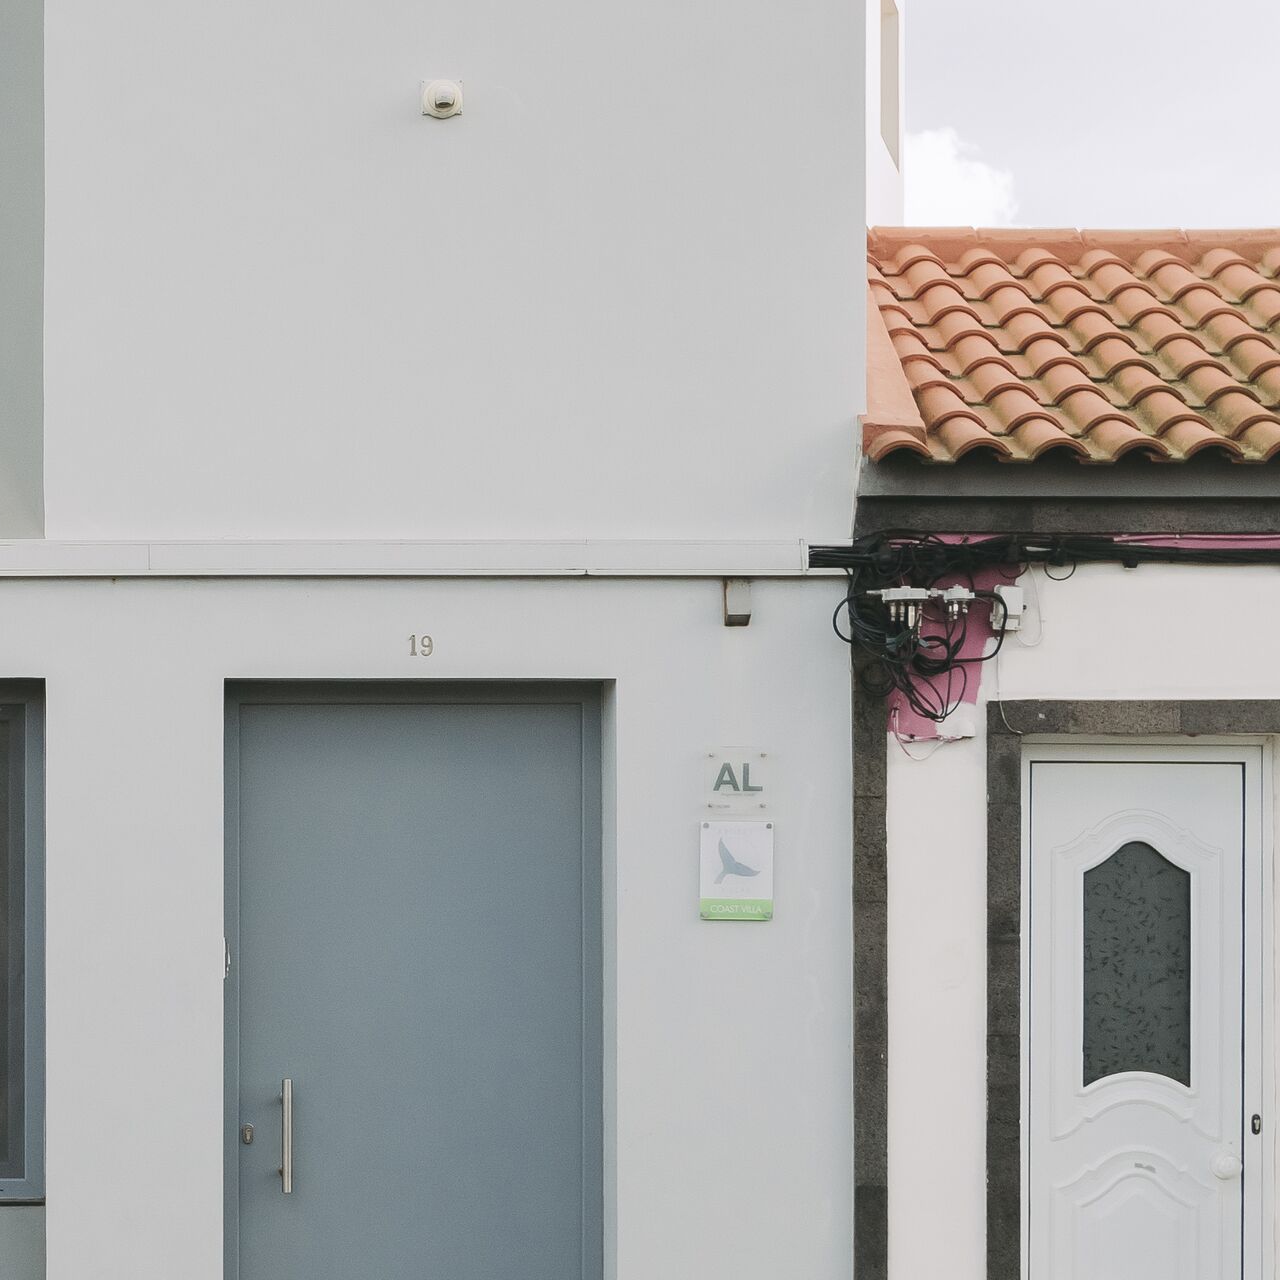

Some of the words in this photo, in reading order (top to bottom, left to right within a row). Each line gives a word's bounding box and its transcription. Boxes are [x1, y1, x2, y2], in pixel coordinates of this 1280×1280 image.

[409, 635, 434, 657] 19
[713, 763, 763, 792] AL
[710, 904, 738, 913] COAST
[740, 904, 762, 913] VILLA
